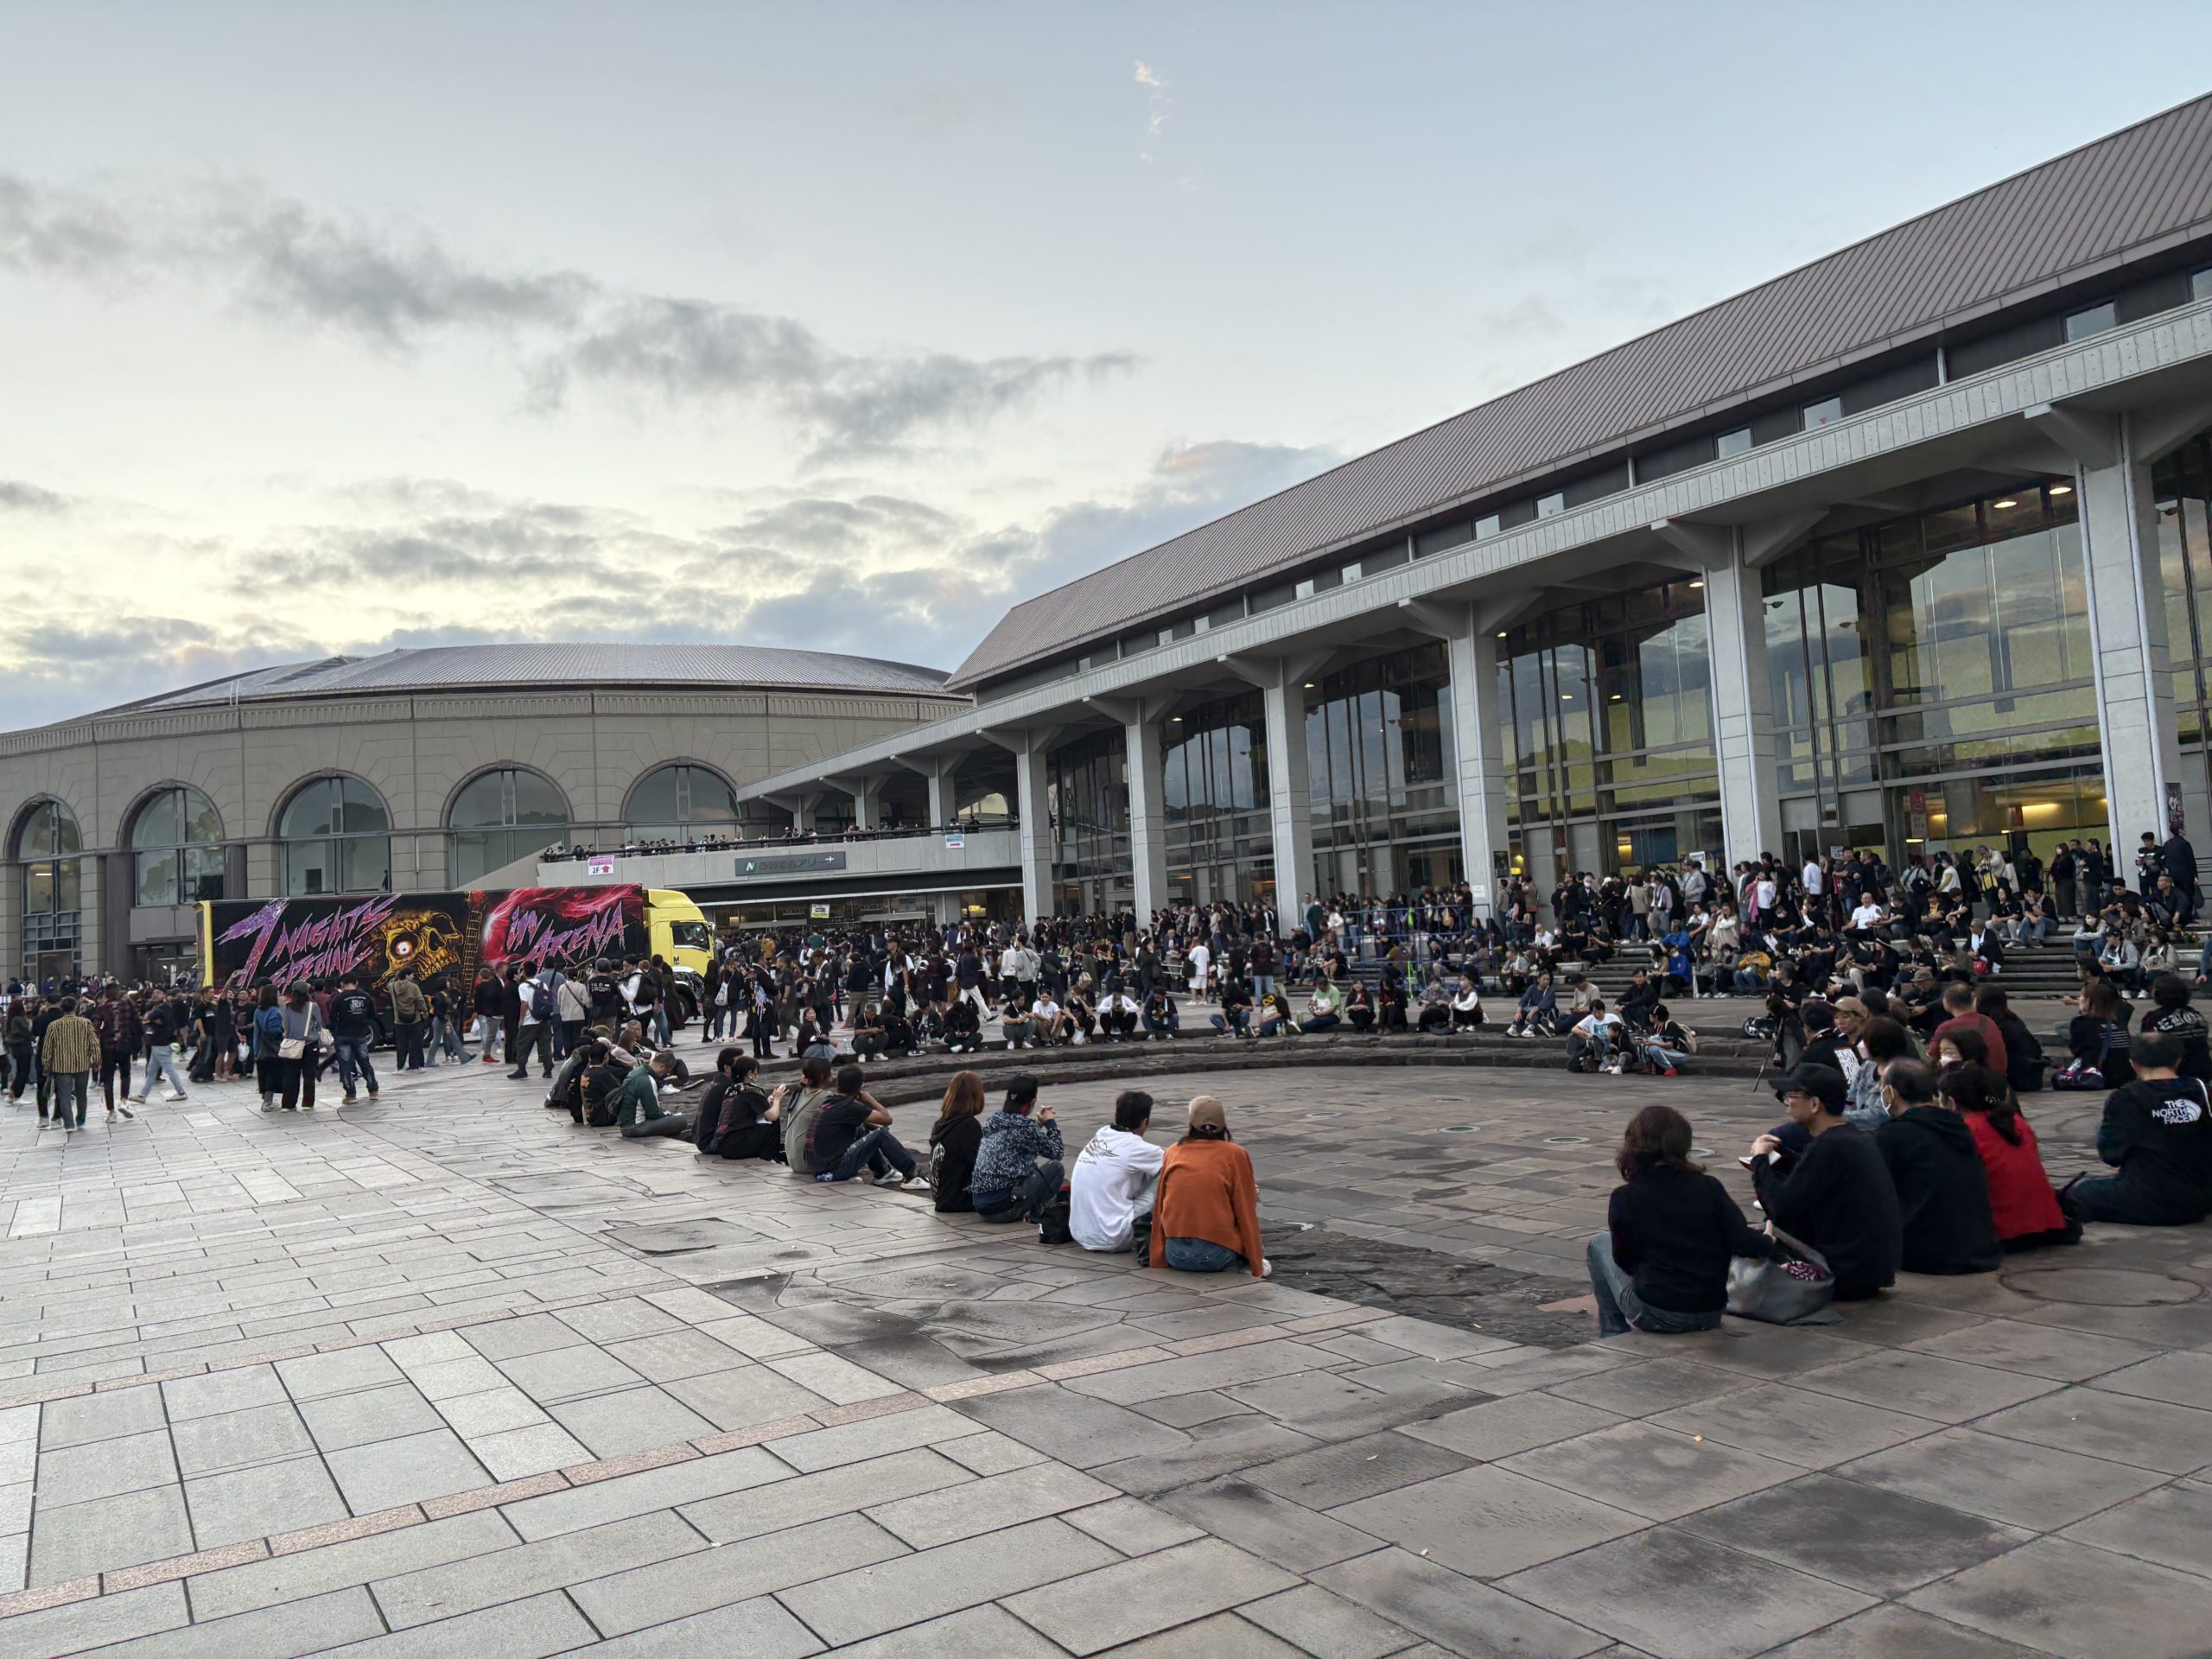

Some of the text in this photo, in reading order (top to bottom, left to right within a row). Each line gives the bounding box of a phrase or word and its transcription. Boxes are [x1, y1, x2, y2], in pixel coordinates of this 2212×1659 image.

[214, 893, 401, 989] 7 NIGHTS
[518, 899, 629, 973] ARENA
[270, 938, 374, 994] SPECIAL
[2152, 1107, 2187, 1117] NORTH
[2164, 1098, 2185, 1109] THE
[2164, 1115, 2190, 1124] FACE
